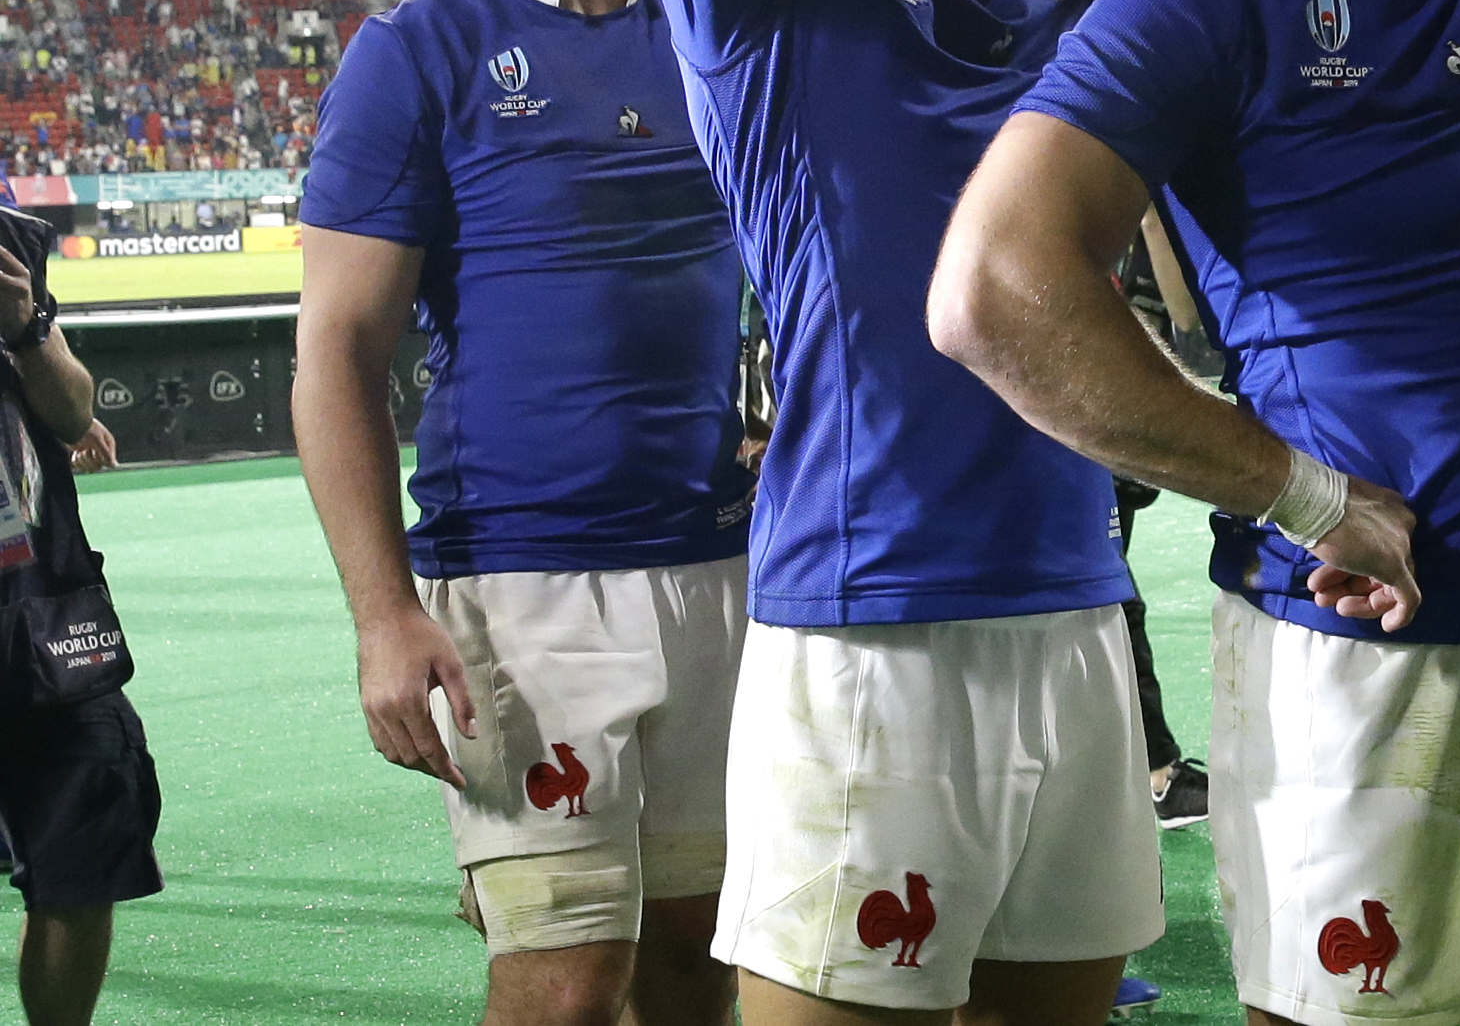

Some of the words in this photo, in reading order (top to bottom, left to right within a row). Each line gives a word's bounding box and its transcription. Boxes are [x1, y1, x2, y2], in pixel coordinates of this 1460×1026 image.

[1320, 57, 1347, 65] RUGBY
[1300, 66, 1344, 77] WORLD
[1310, 79, 1333, 87] JAPAN
[490, 101, 526, 111] WORLD
[527, 100, 547, 109] CUP
[100, 229, 240, 256] mastercard
[68, 622, 98, 636] RUGBY
[47, 636, 98, 656] WORLD
[99, 630, 122, 647] CUP
[67, 656, 92, 668] JAPAN
